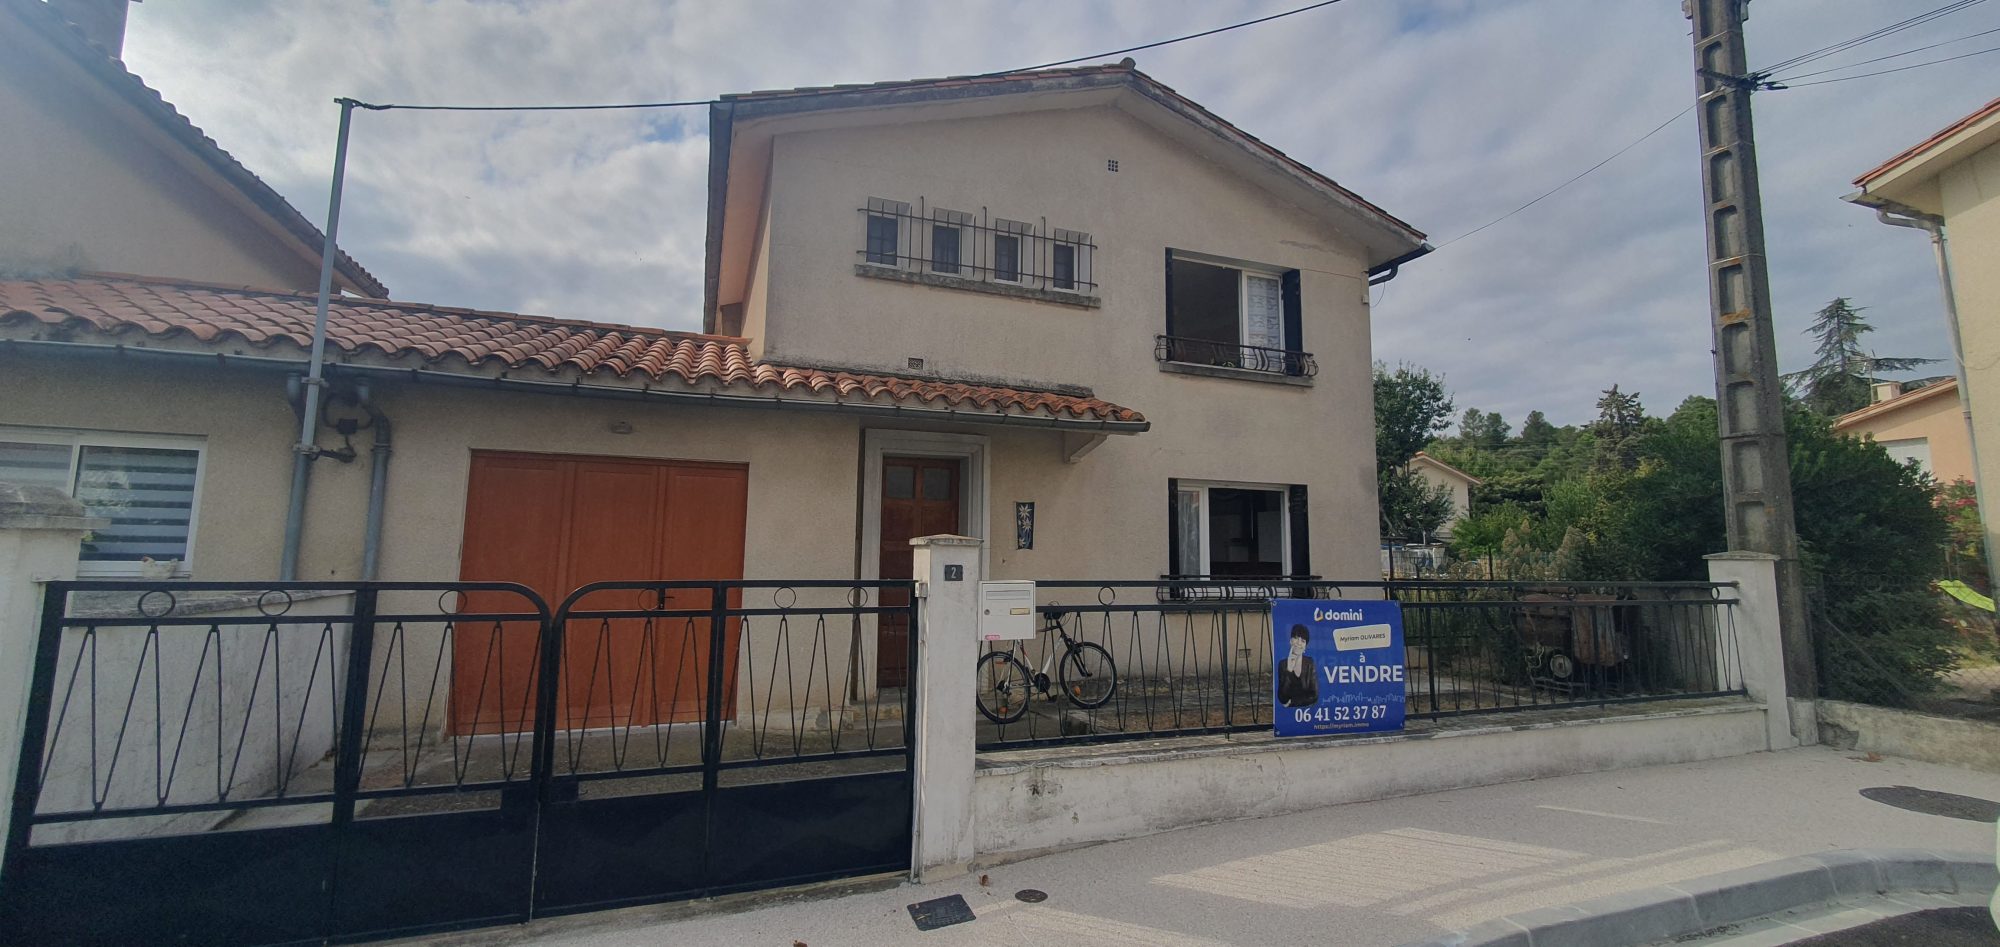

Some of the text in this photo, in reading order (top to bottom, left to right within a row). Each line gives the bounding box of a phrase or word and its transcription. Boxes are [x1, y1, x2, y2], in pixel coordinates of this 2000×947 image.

[951, 566, 957, 578] 2
[1325, 608, 1363, 621] domini
[1340, 635, 1360, 643] Myriam
[1359, 652, 1366, 663] à
[1324, 665, 1403, 684] VENDRE
[1295, 705, 1387, 722] 06 41 52 37 87
